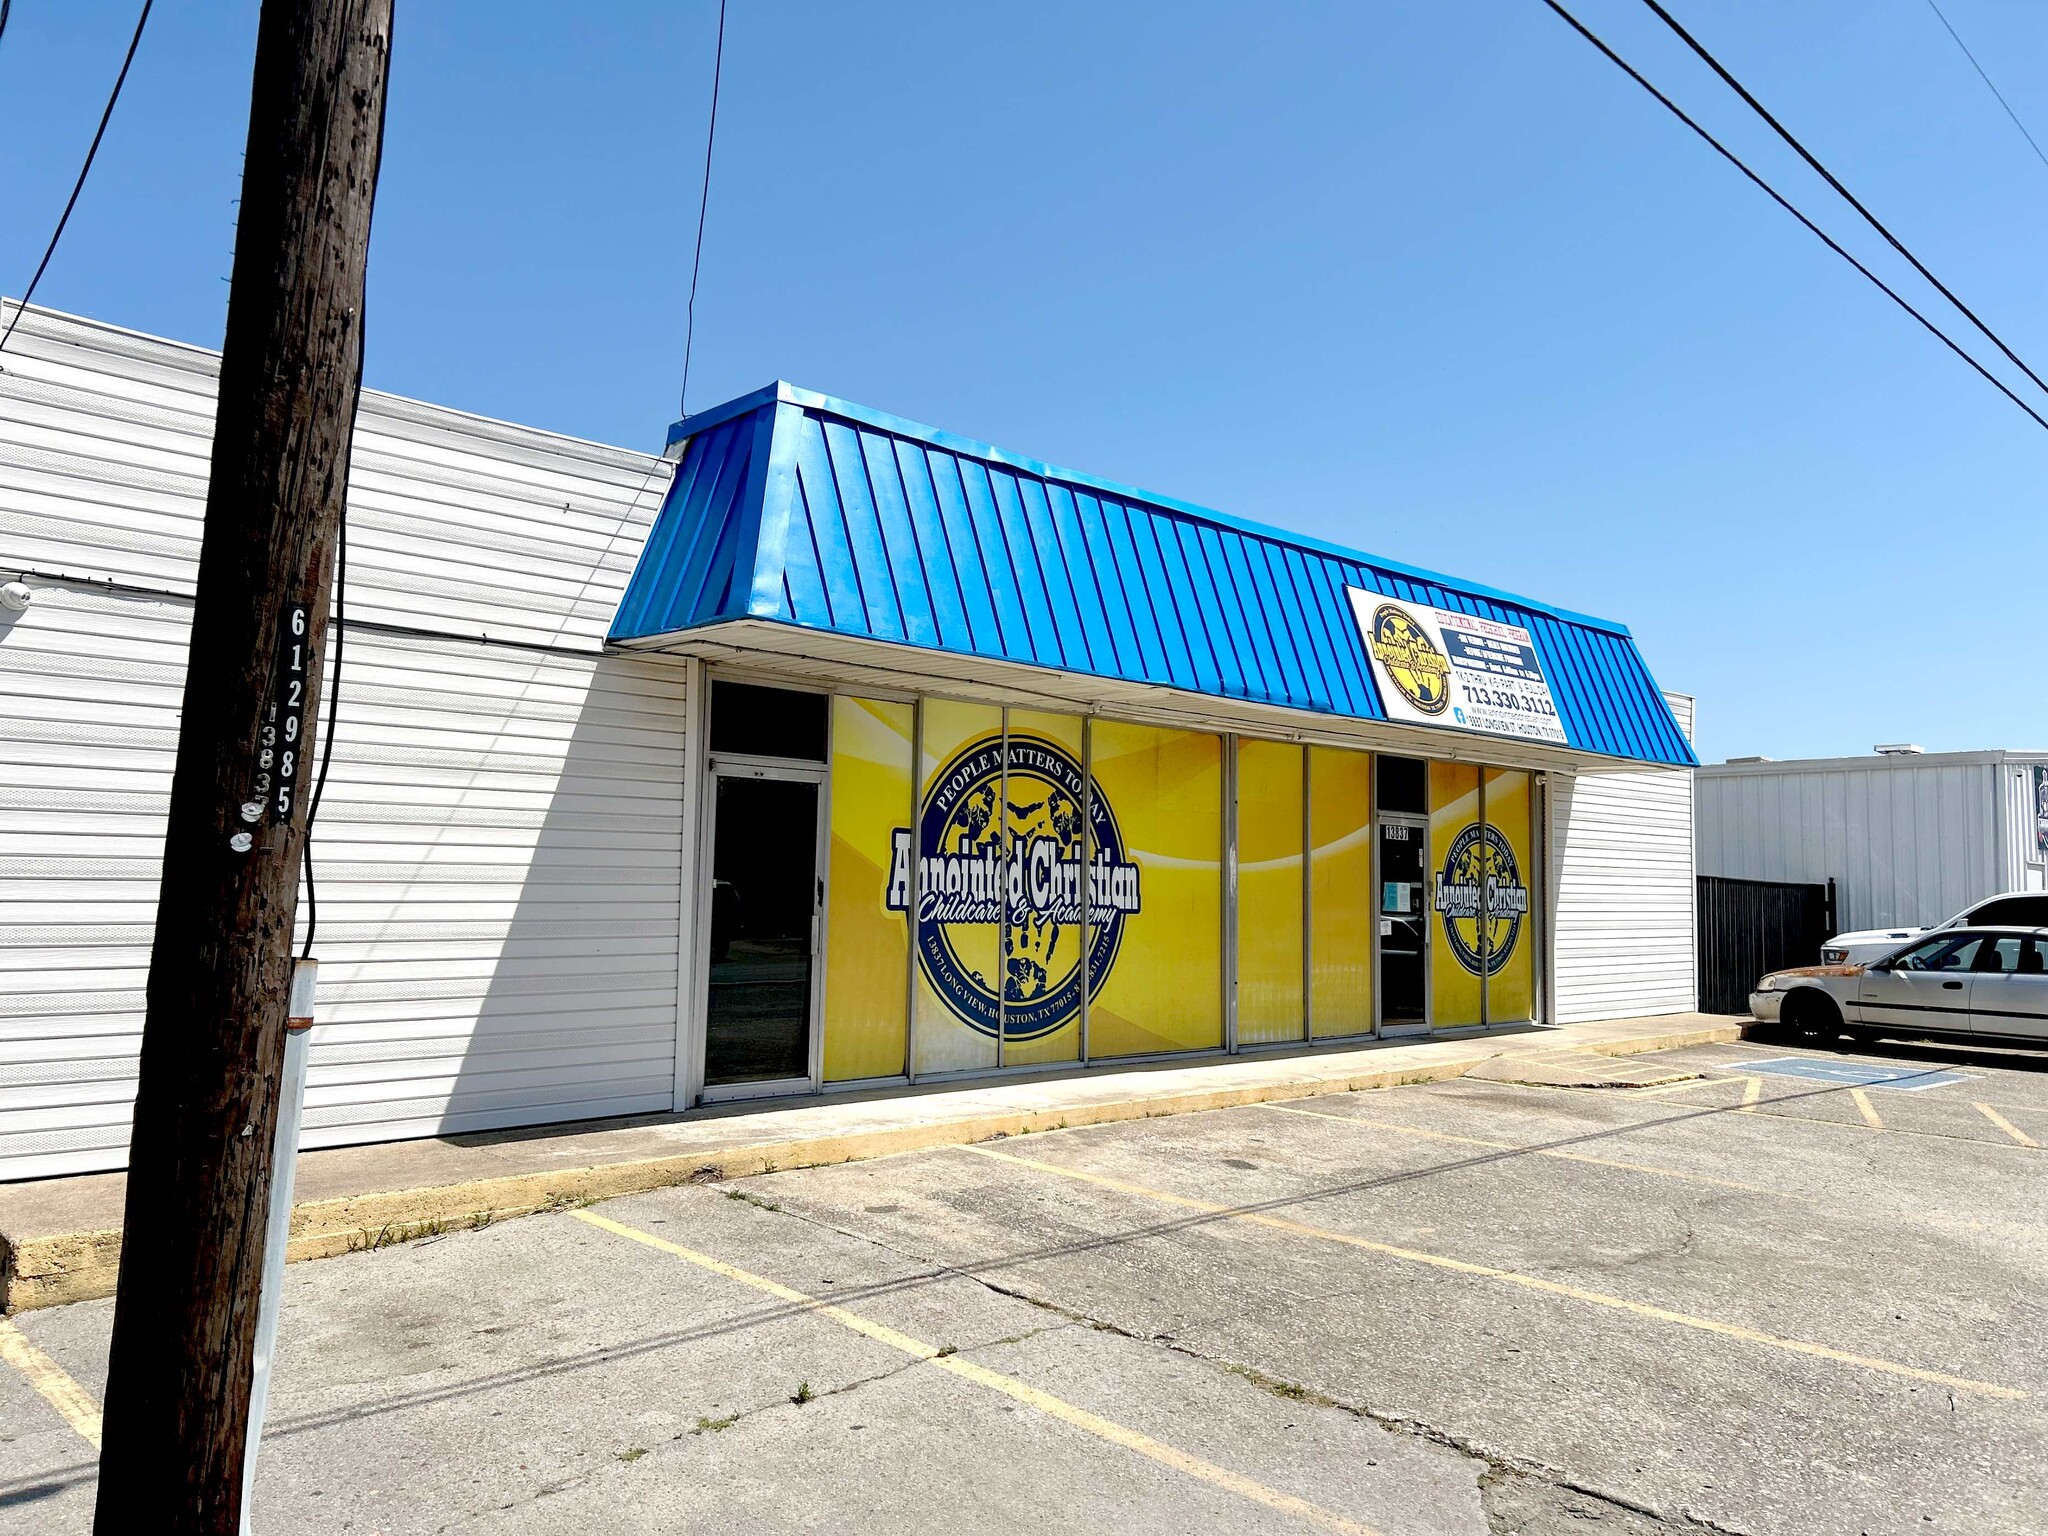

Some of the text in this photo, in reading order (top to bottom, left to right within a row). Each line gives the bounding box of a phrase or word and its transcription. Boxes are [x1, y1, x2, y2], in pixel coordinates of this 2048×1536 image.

[278, 609, 305, 813] 612985
[1462, 685, 1556, 716] 713.330.3112
[936, 754, 990, 812] PEOPLE
[992, 748, 1064, 777] MATTERS
[1387, 826, 1409, 840] 13837
[1451, 833, 1471, 863] PEOPLE
[1470, 829, 1498, 844] MAERS
[1498, 841, 1514, 867] TODAY
[890, 832, 1023, 909] Annointed
[919, 894, 1002, 923] Childcare
[1012, 897, 1031, 924] &
[1487, 875, 1527, 912] Christian
[927, 935, 944, 966] 13837
[1038, 1006, 1051, 1019] TX
